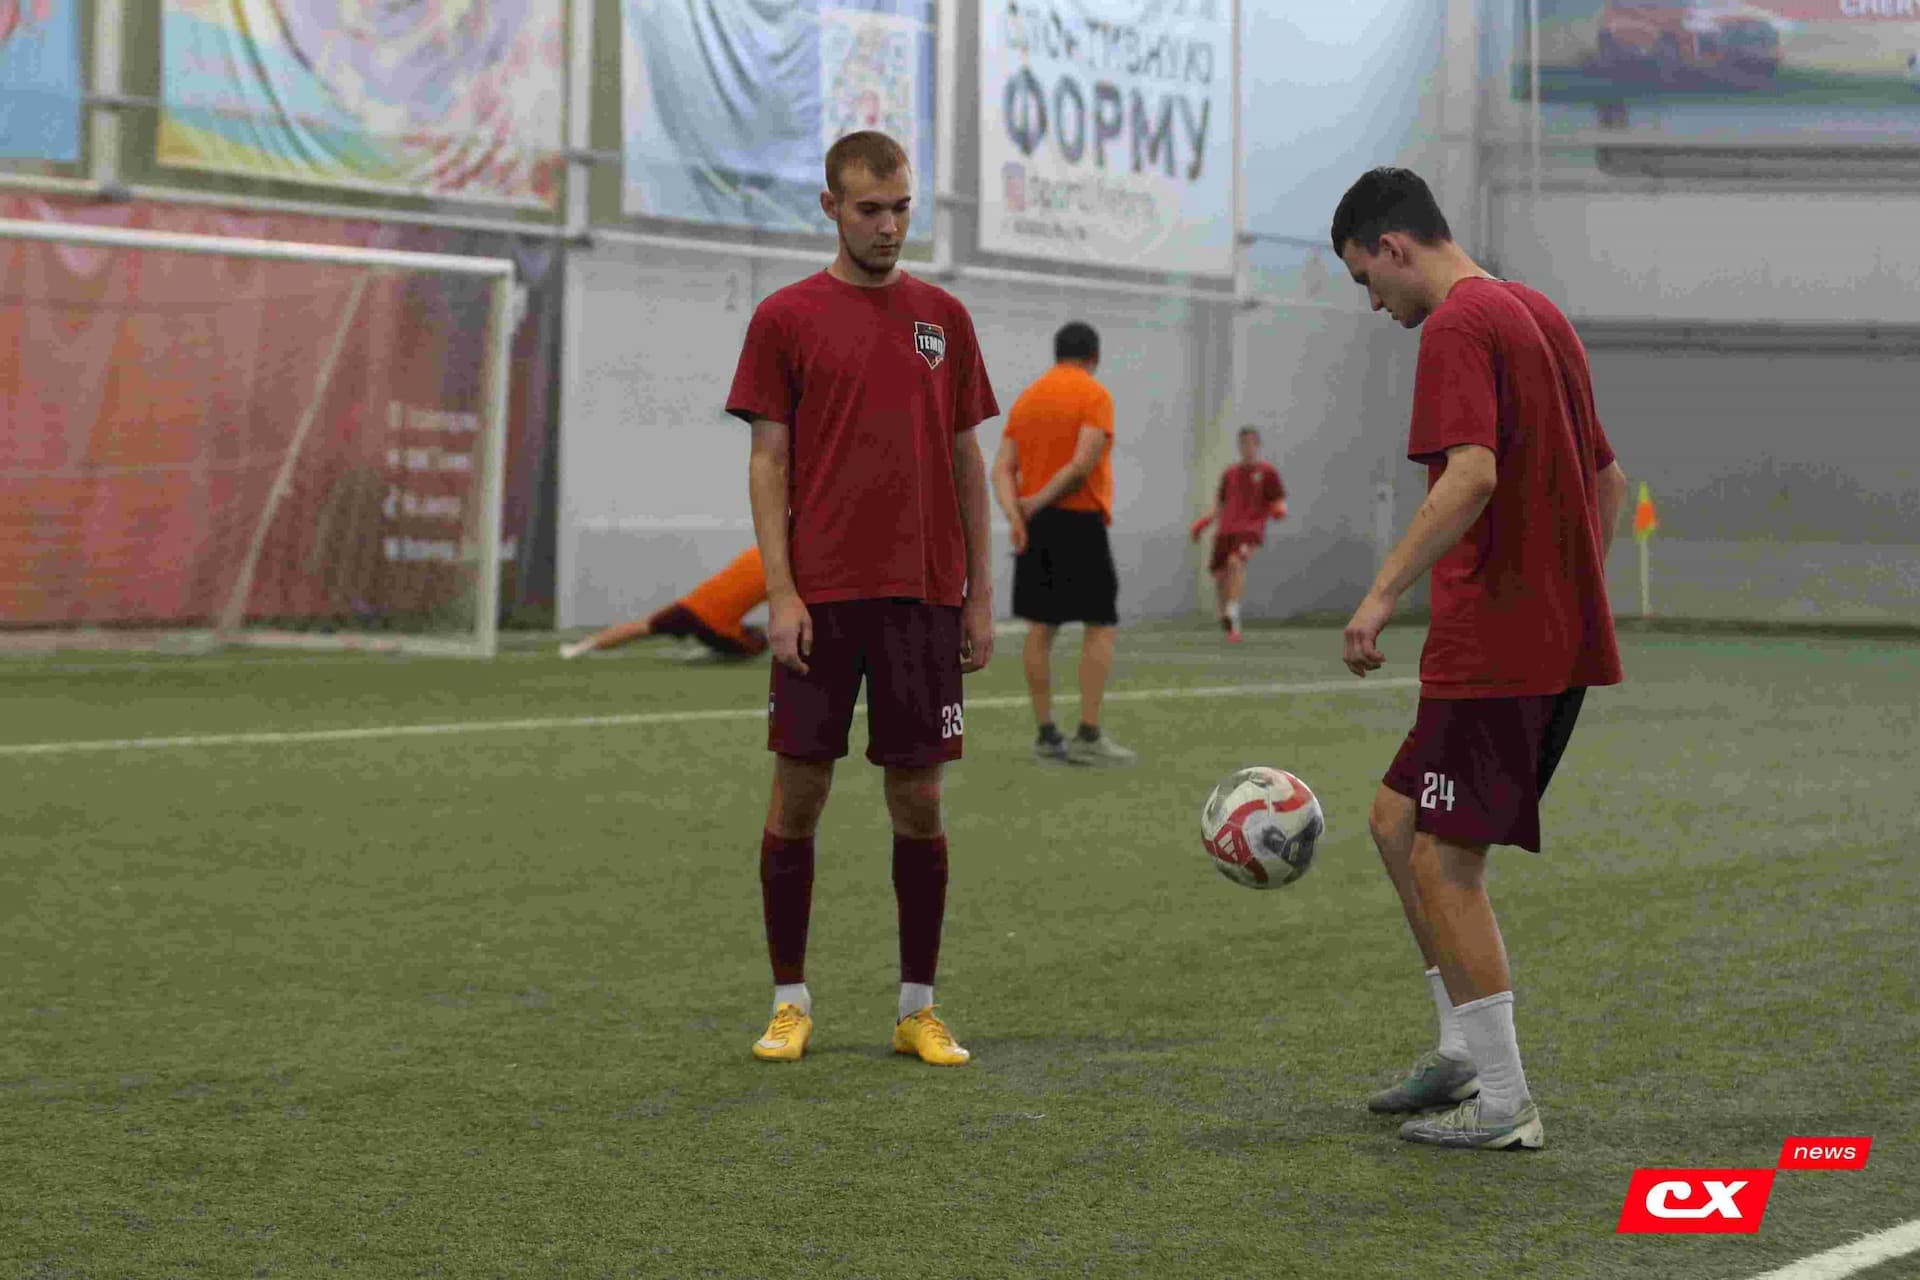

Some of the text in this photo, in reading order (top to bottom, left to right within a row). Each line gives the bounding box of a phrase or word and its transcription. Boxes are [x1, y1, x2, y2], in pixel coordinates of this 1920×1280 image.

[1004, 66, 1210, 181] ФОРМУ
[942, 702, 963, 739] 33
[1420, 771, 1456, 811] 24
